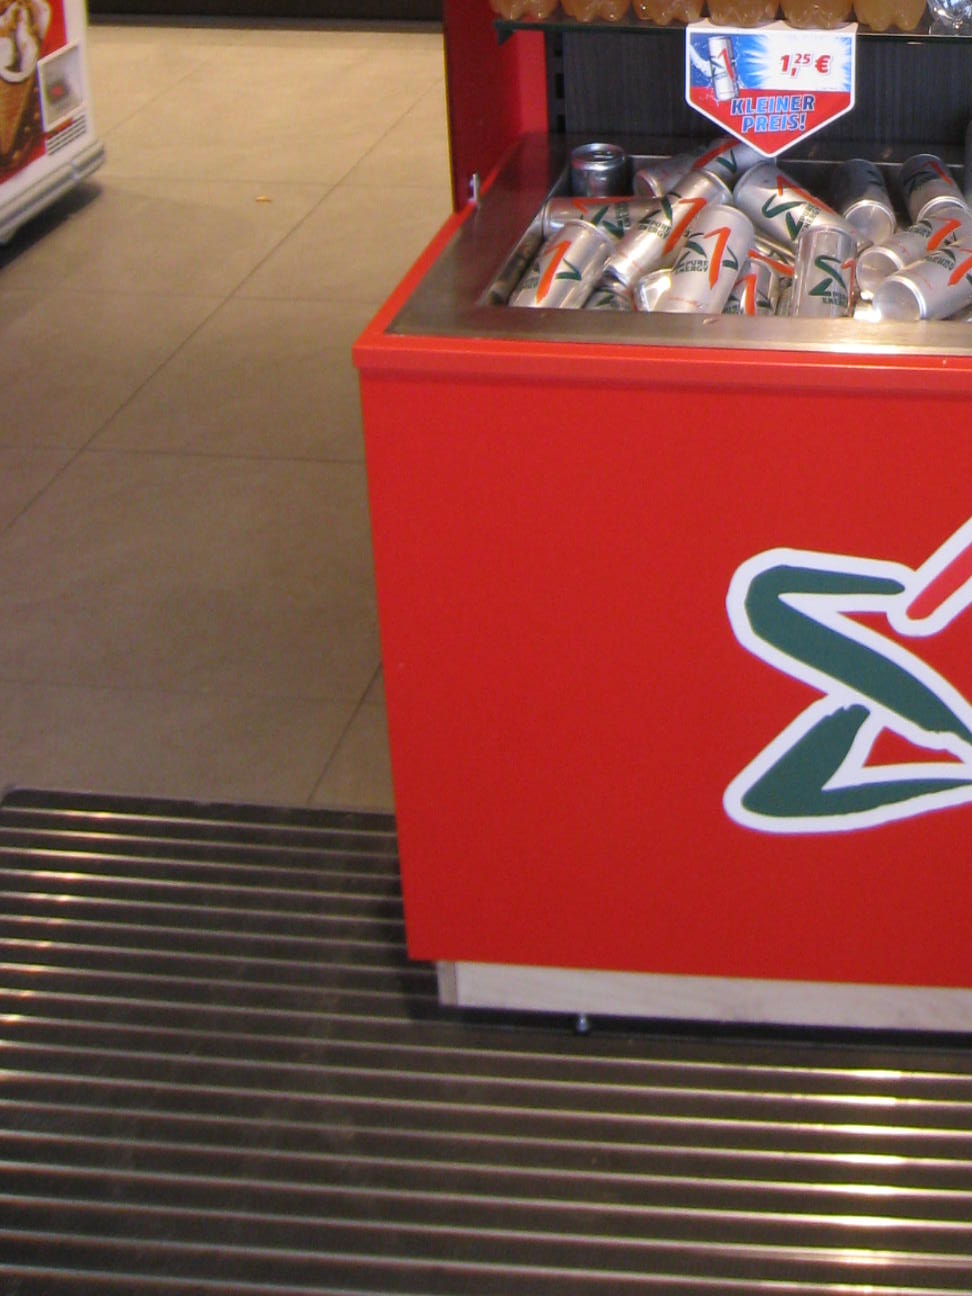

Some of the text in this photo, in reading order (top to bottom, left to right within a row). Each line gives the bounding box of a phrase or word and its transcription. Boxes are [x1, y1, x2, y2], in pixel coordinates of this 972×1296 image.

[814, 54, 831, 74] €
[730, 94, 816, 116] KLEINER
[741, 113, 807, 134] PREIS!
